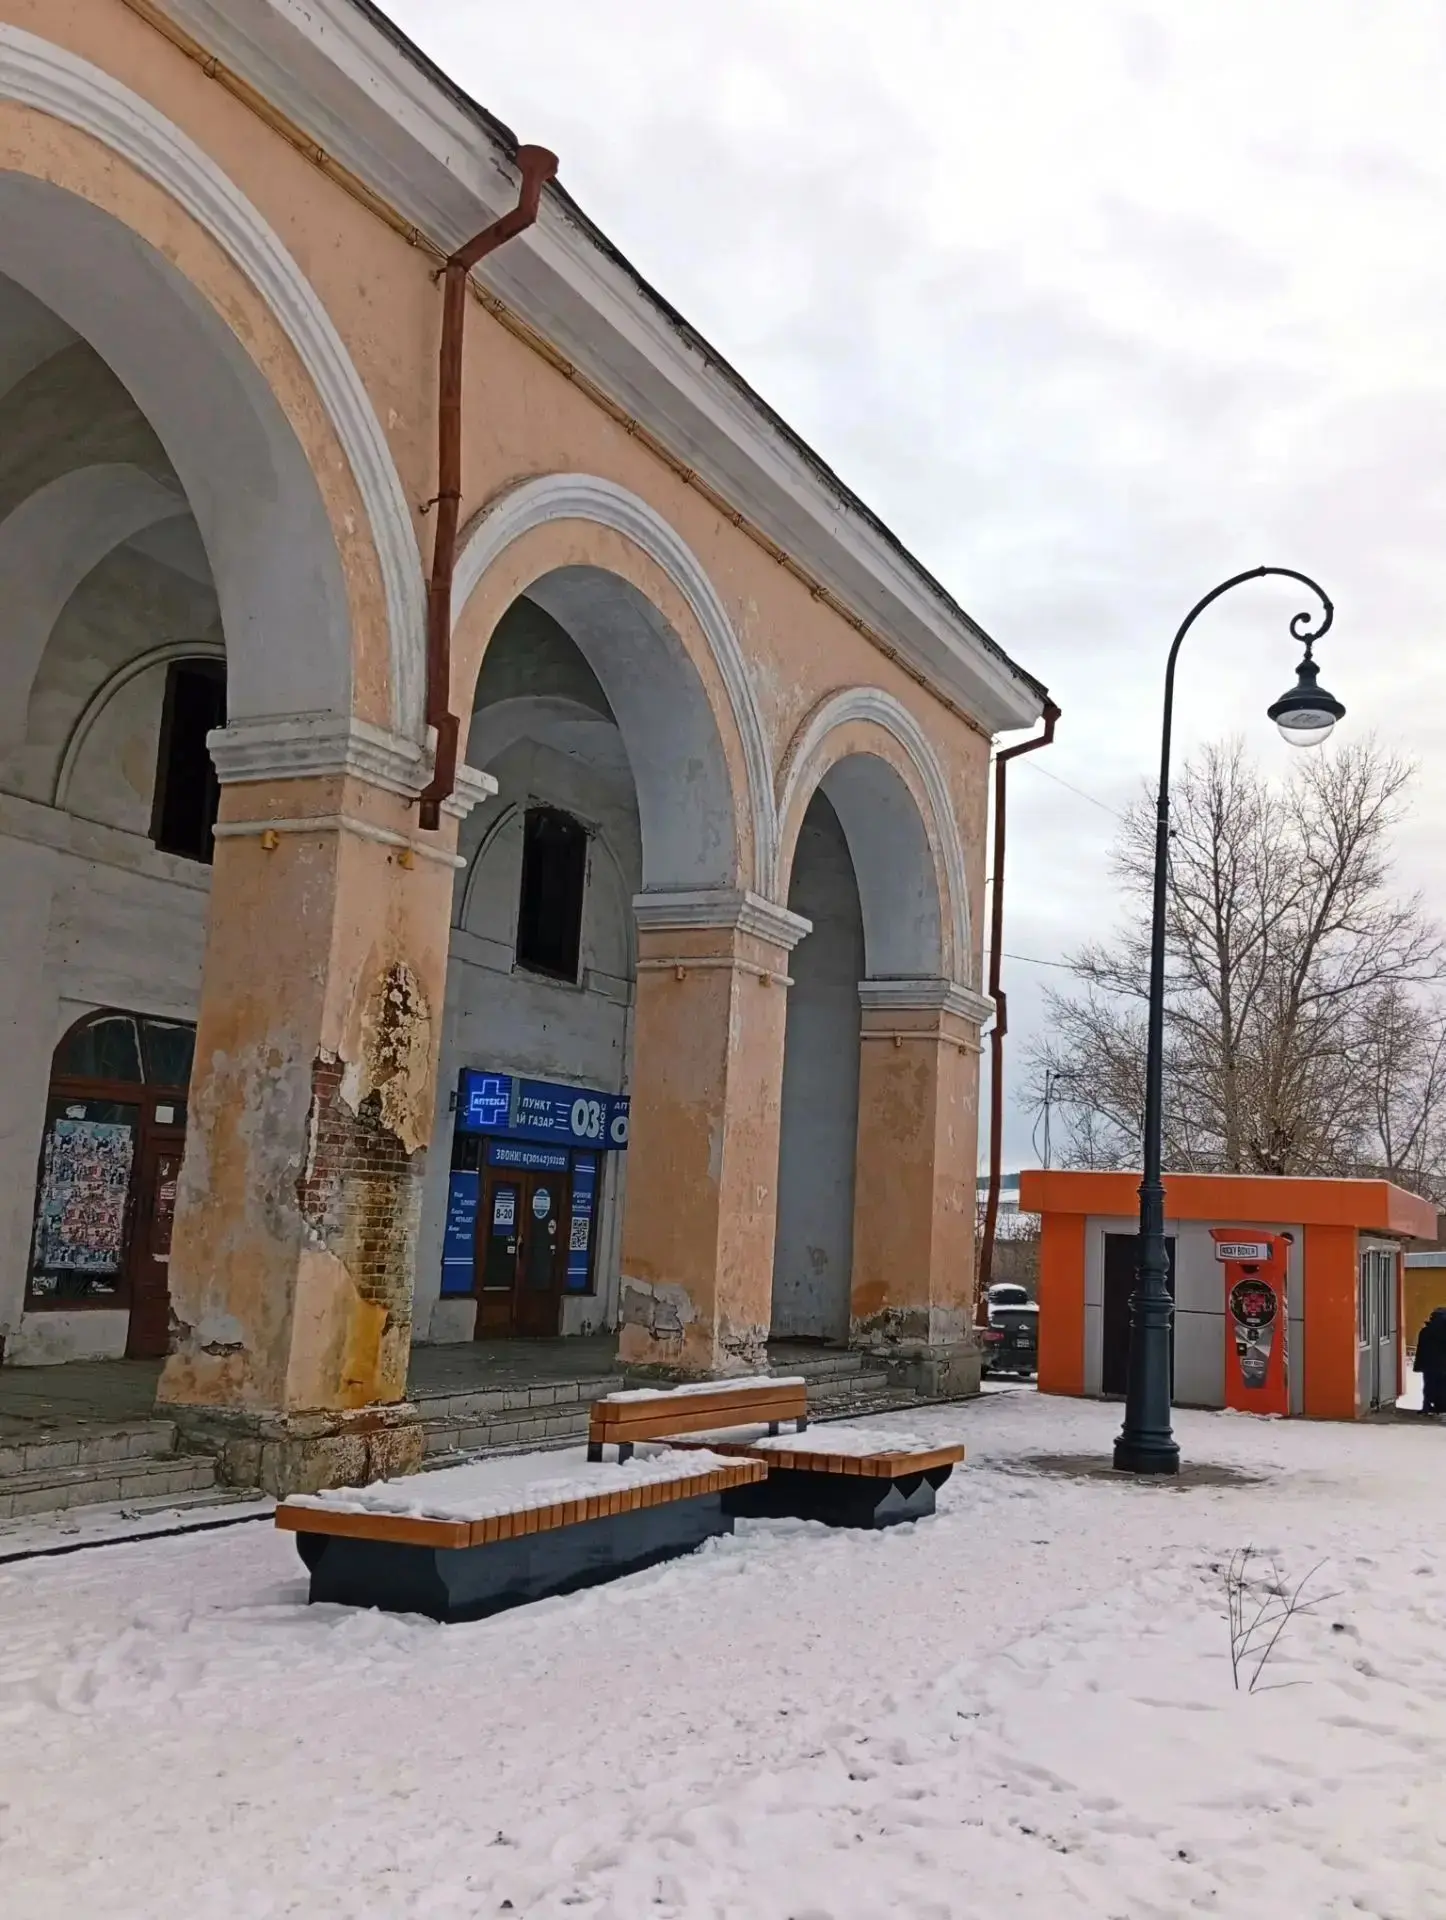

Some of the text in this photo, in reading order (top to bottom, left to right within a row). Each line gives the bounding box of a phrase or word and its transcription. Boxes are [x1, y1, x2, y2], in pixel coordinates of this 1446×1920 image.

[473, 1098, 506, 1106] АПТЕКА
[522, 1097, 552, 1111] ПУНКТ
[614, 1101, 629, 1110] АП
[527, 1114, 554, 1128] ГАЗАР
[571, 1098, 600, 1138] 03
[599, 1103, 607, 1140] ПЛЮС
[496, 1208, 513, 1220] 8-20
